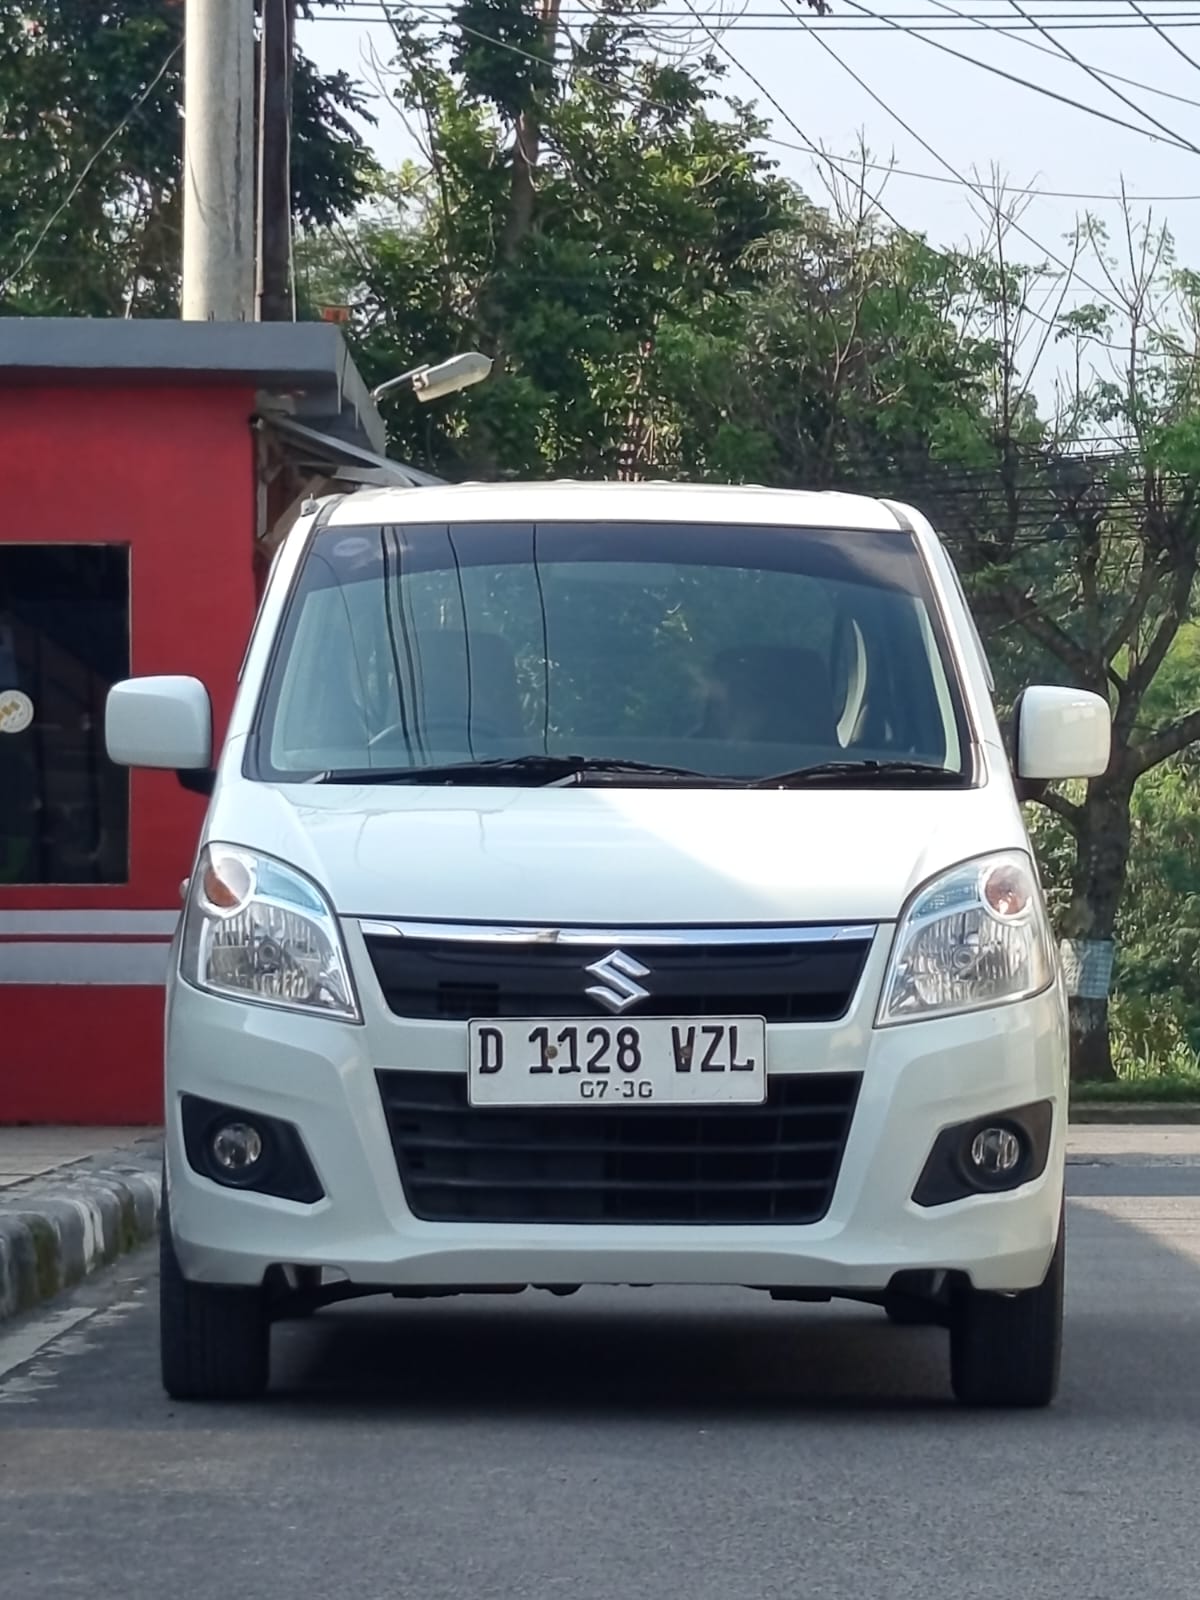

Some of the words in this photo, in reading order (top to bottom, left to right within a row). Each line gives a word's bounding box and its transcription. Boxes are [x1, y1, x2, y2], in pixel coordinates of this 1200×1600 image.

[478, 1027, 503, 1074] D
[528, 1027, 642, 1074] 1128
[671, 1025, 755, 1073] VZL
